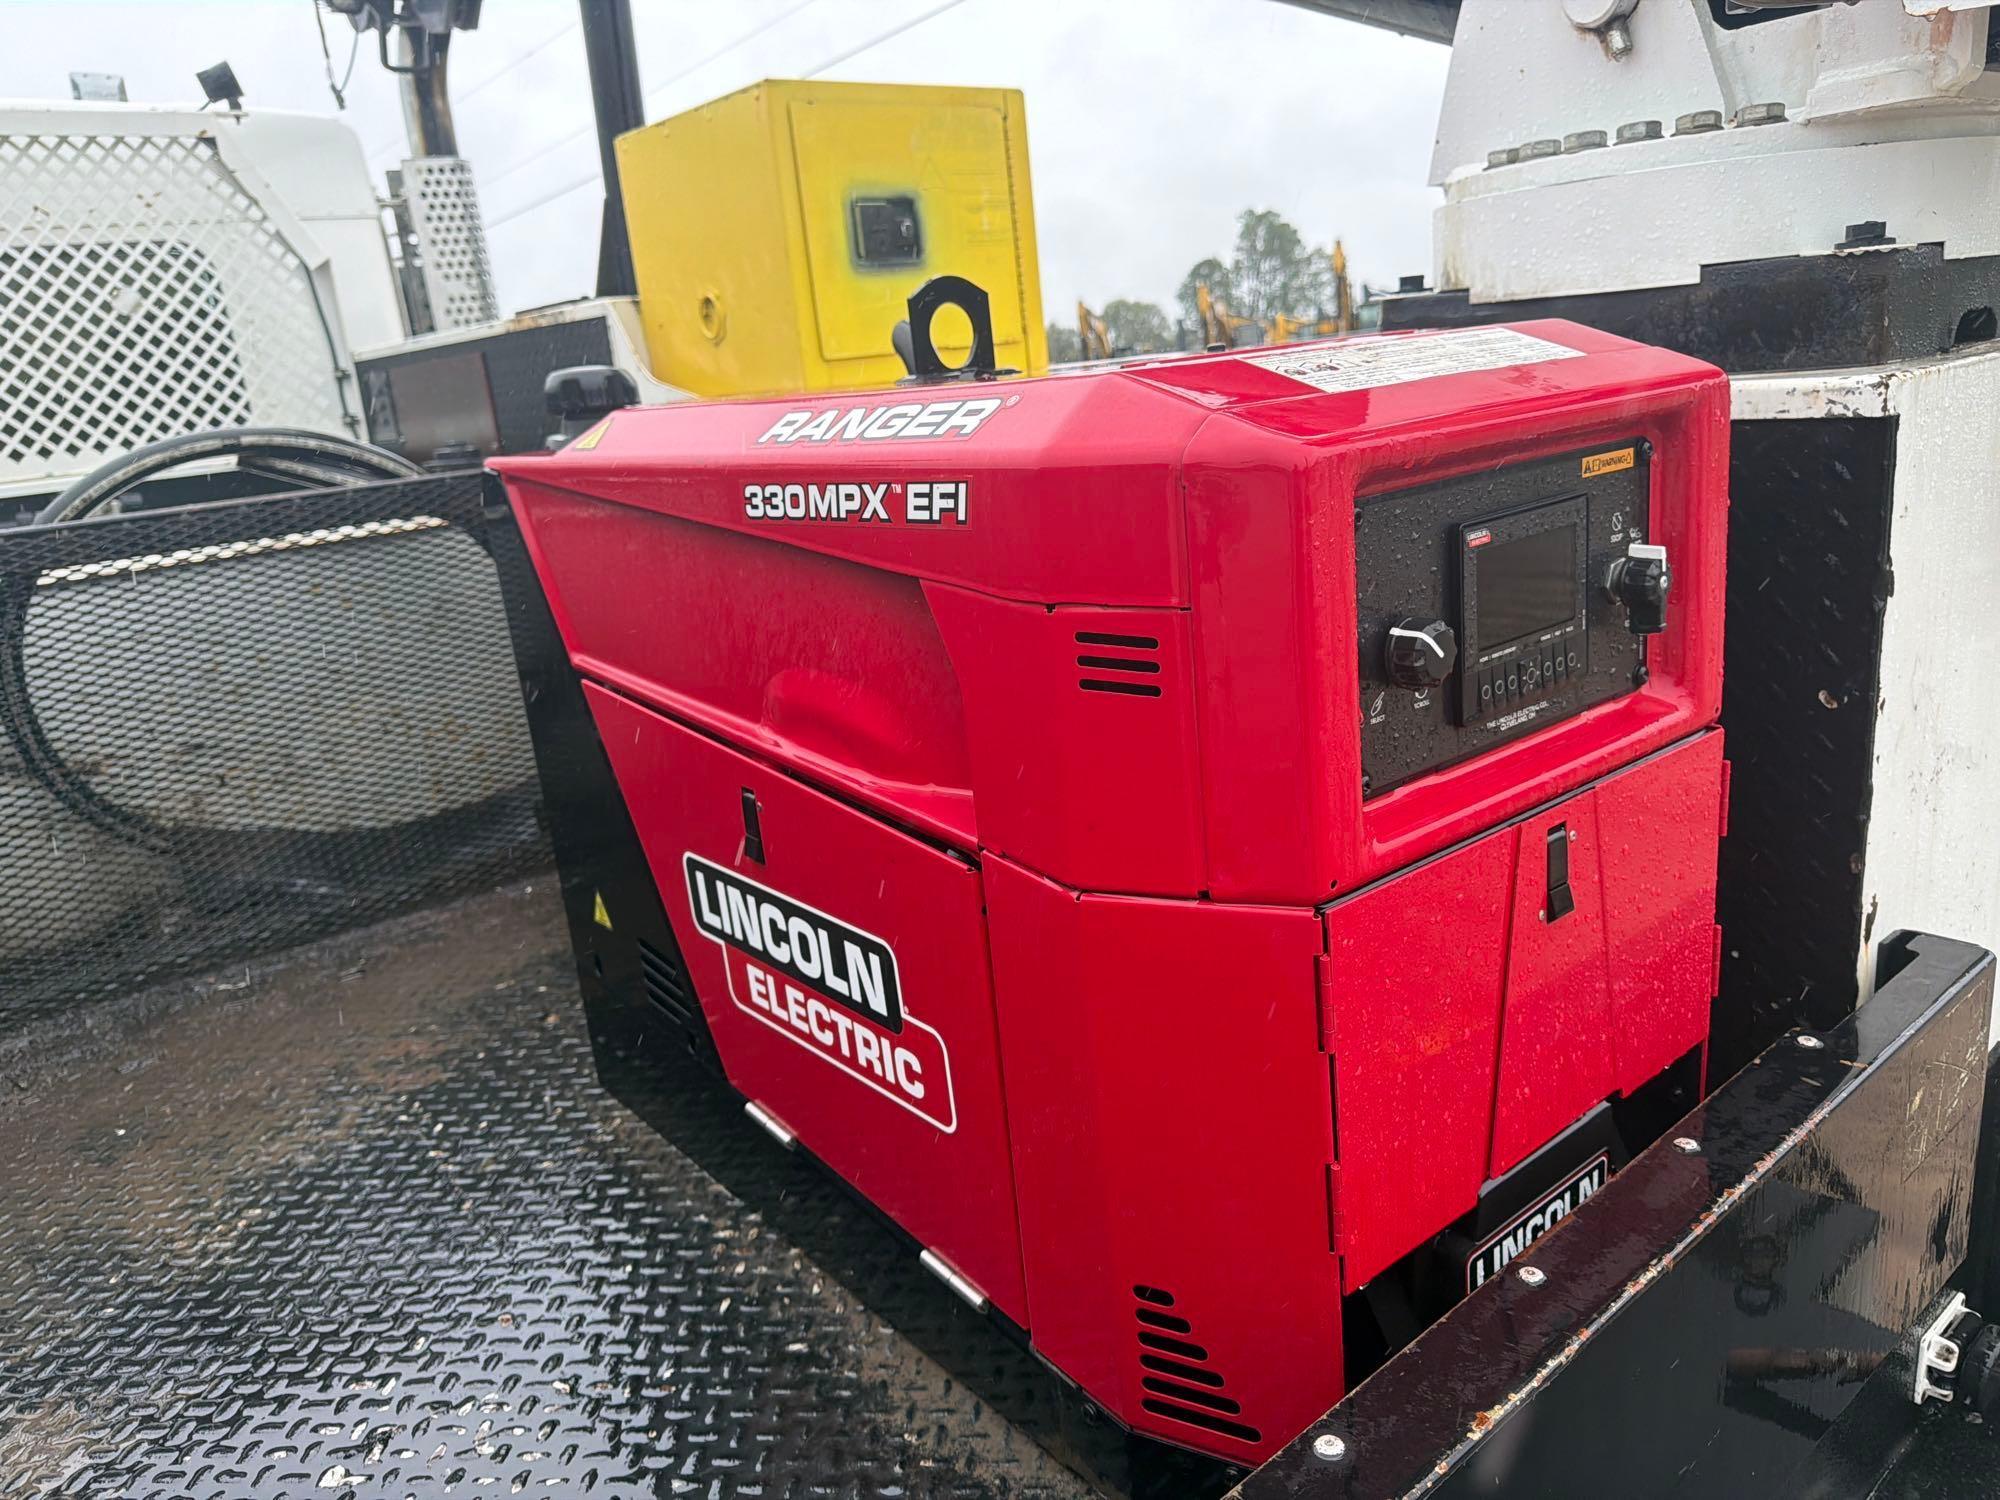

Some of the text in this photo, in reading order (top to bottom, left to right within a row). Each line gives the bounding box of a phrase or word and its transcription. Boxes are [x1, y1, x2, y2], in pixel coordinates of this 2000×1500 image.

[906, 482, 968, 522] EFI
[695, 869, 889, 1018] LINCOLN
[746, 963, 925, 1099] ELECTRIC
